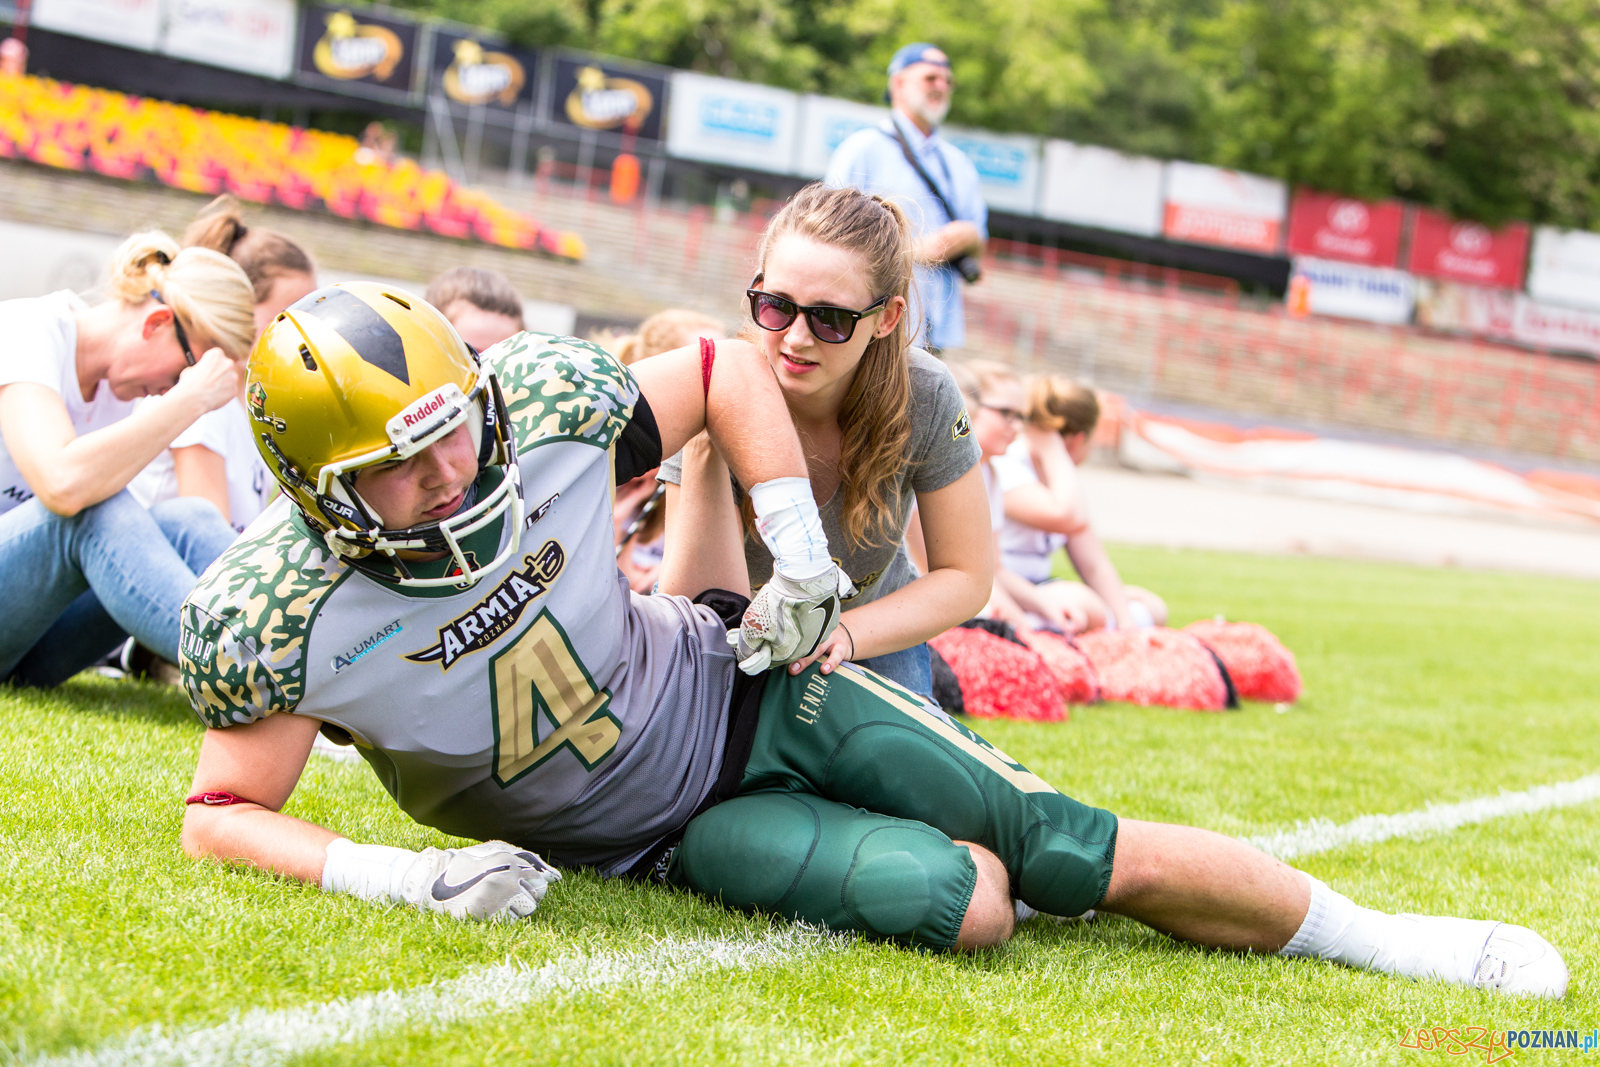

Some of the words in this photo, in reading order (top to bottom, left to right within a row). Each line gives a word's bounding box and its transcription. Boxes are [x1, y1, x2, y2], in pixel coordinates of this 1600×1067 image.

[403, 393, 446, 427] Riddell
[331, 618, 401, 674] ALUMART
[443, 574, 540, 664] ARMIA
[477, 613, 515, 646] POZNAŃ
[489, 605, 623, 790] 4
